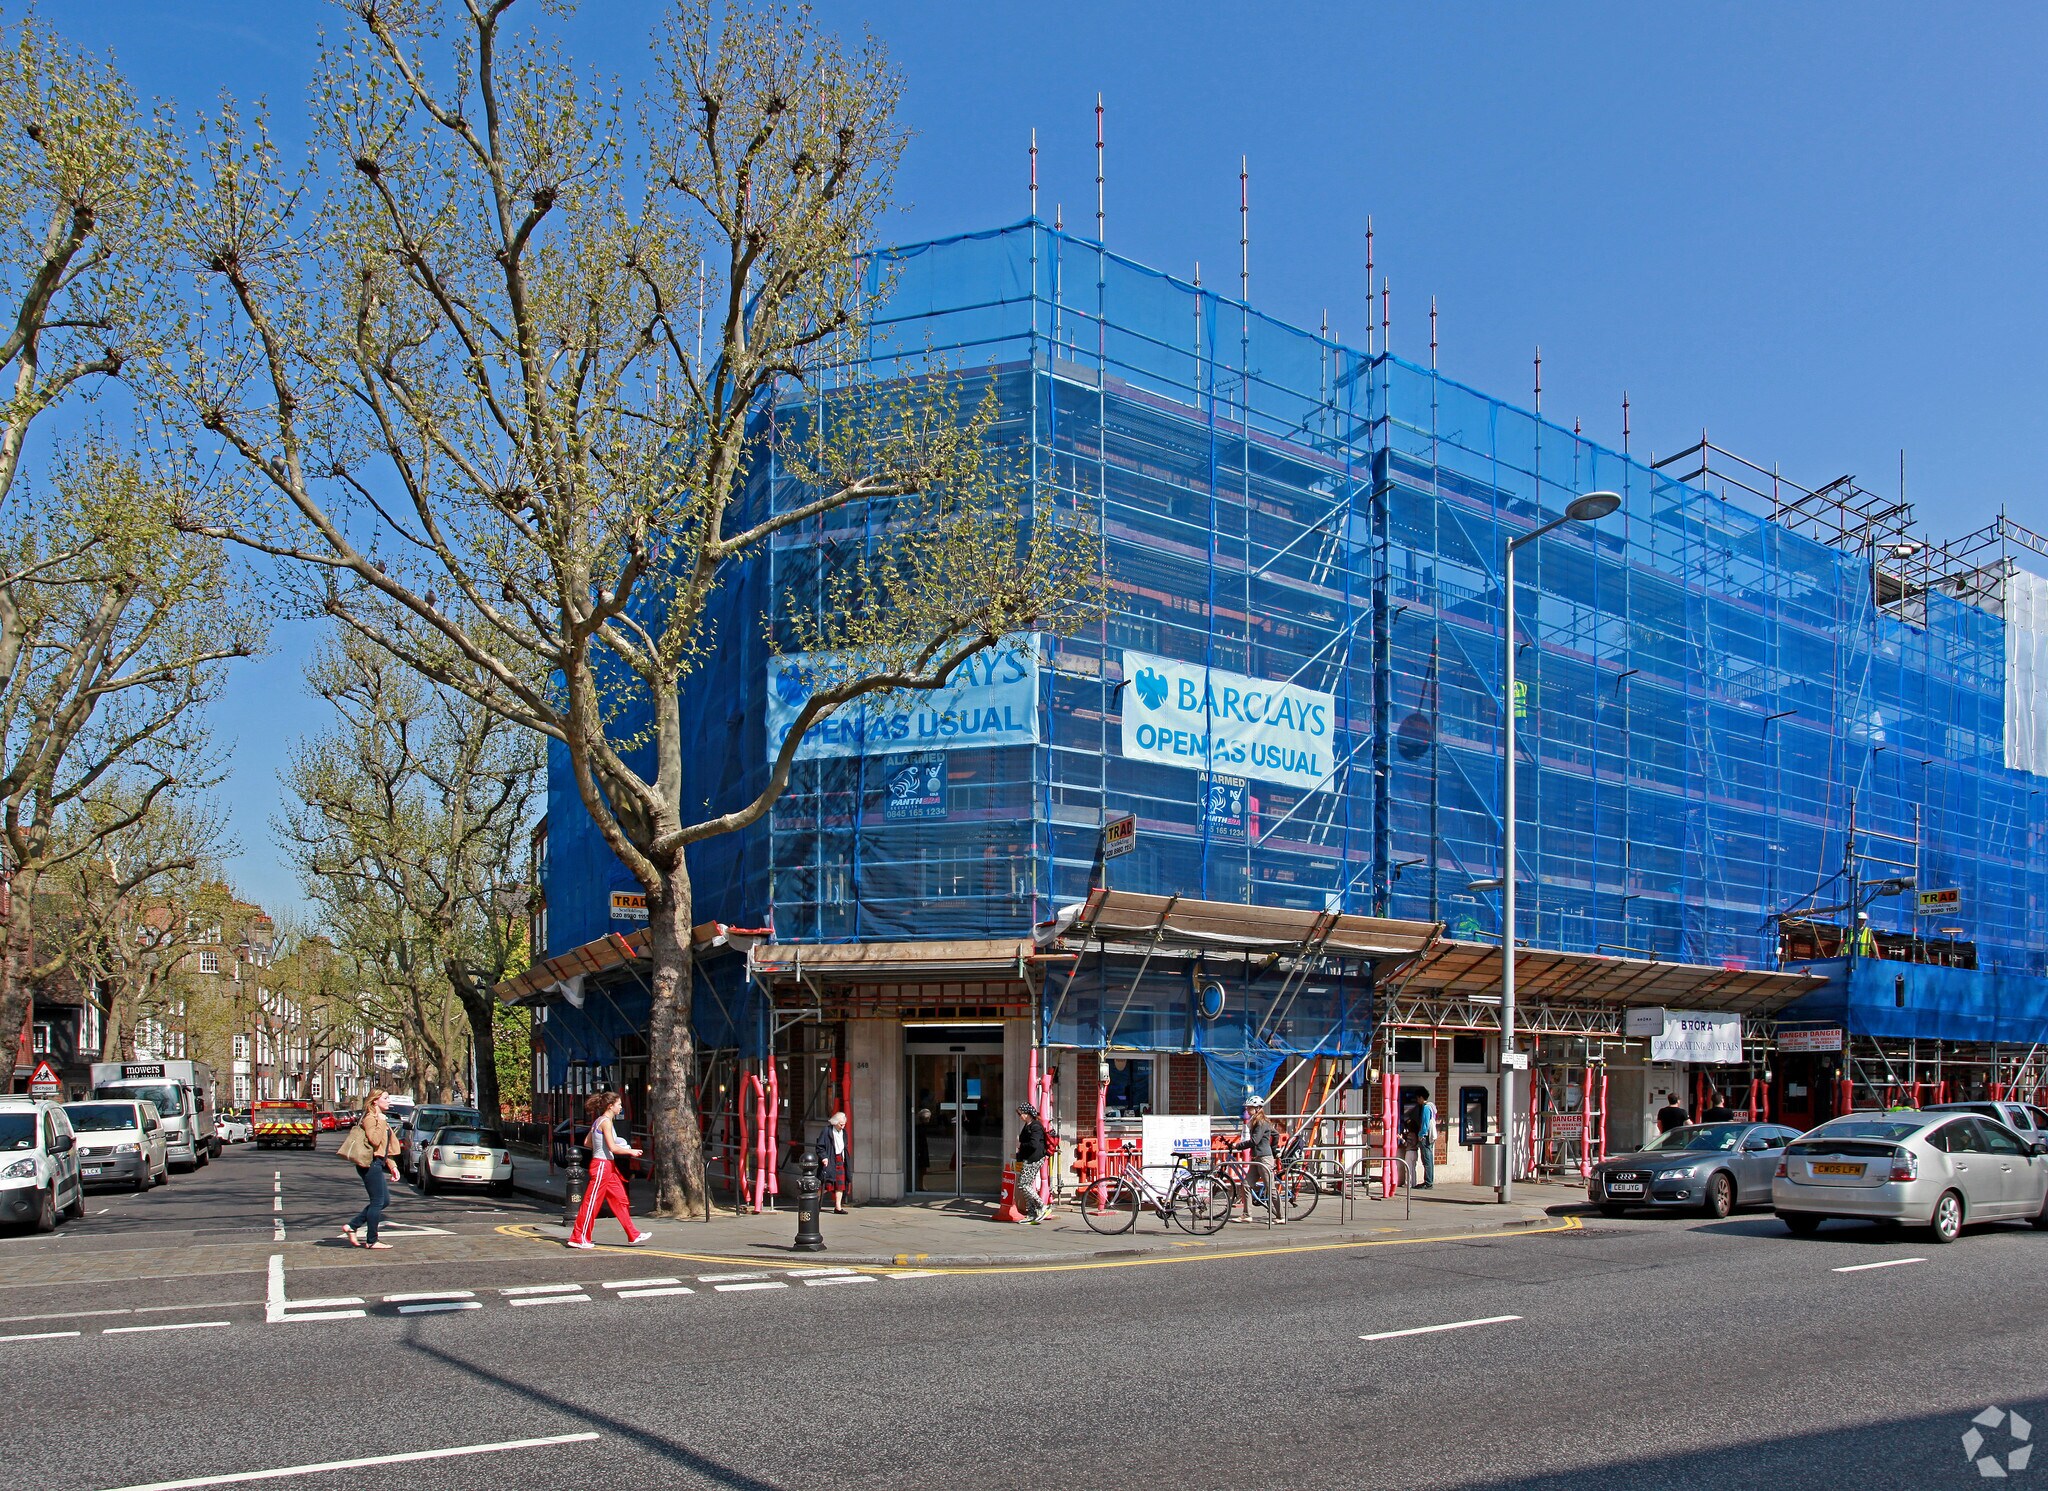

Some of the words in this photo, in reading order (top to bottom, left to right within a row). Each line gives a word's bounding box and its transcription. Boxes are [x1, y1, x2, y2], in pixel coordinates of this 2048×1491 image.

[1177, 678, 1325, 737] BARCLAYS
[869, 714, 910, 741] AS
[918, 705, 1023, 739] USUAL
[1136, 723, 1209, 756] OPEN
[1213, 737, 1246, 764] AS
[1251, 742, 1323, 777] USUAL
[886, 753, 945, 766] ALARMED
[891, 797, 941, 806] PANTHERA
[887, 809, 906, 818] 0845
[909, 808, 923, 816] 165
[926, 807, 946, 815] 1234
[1109, 821, 1133, 839] TRAD
[1216, 826, 1228, 834] 165
[1229, 828, 1244, 837] 1234
[1922, 893, 1956, 902] TRAD
[126, 1066, 161, 1075] mowers
